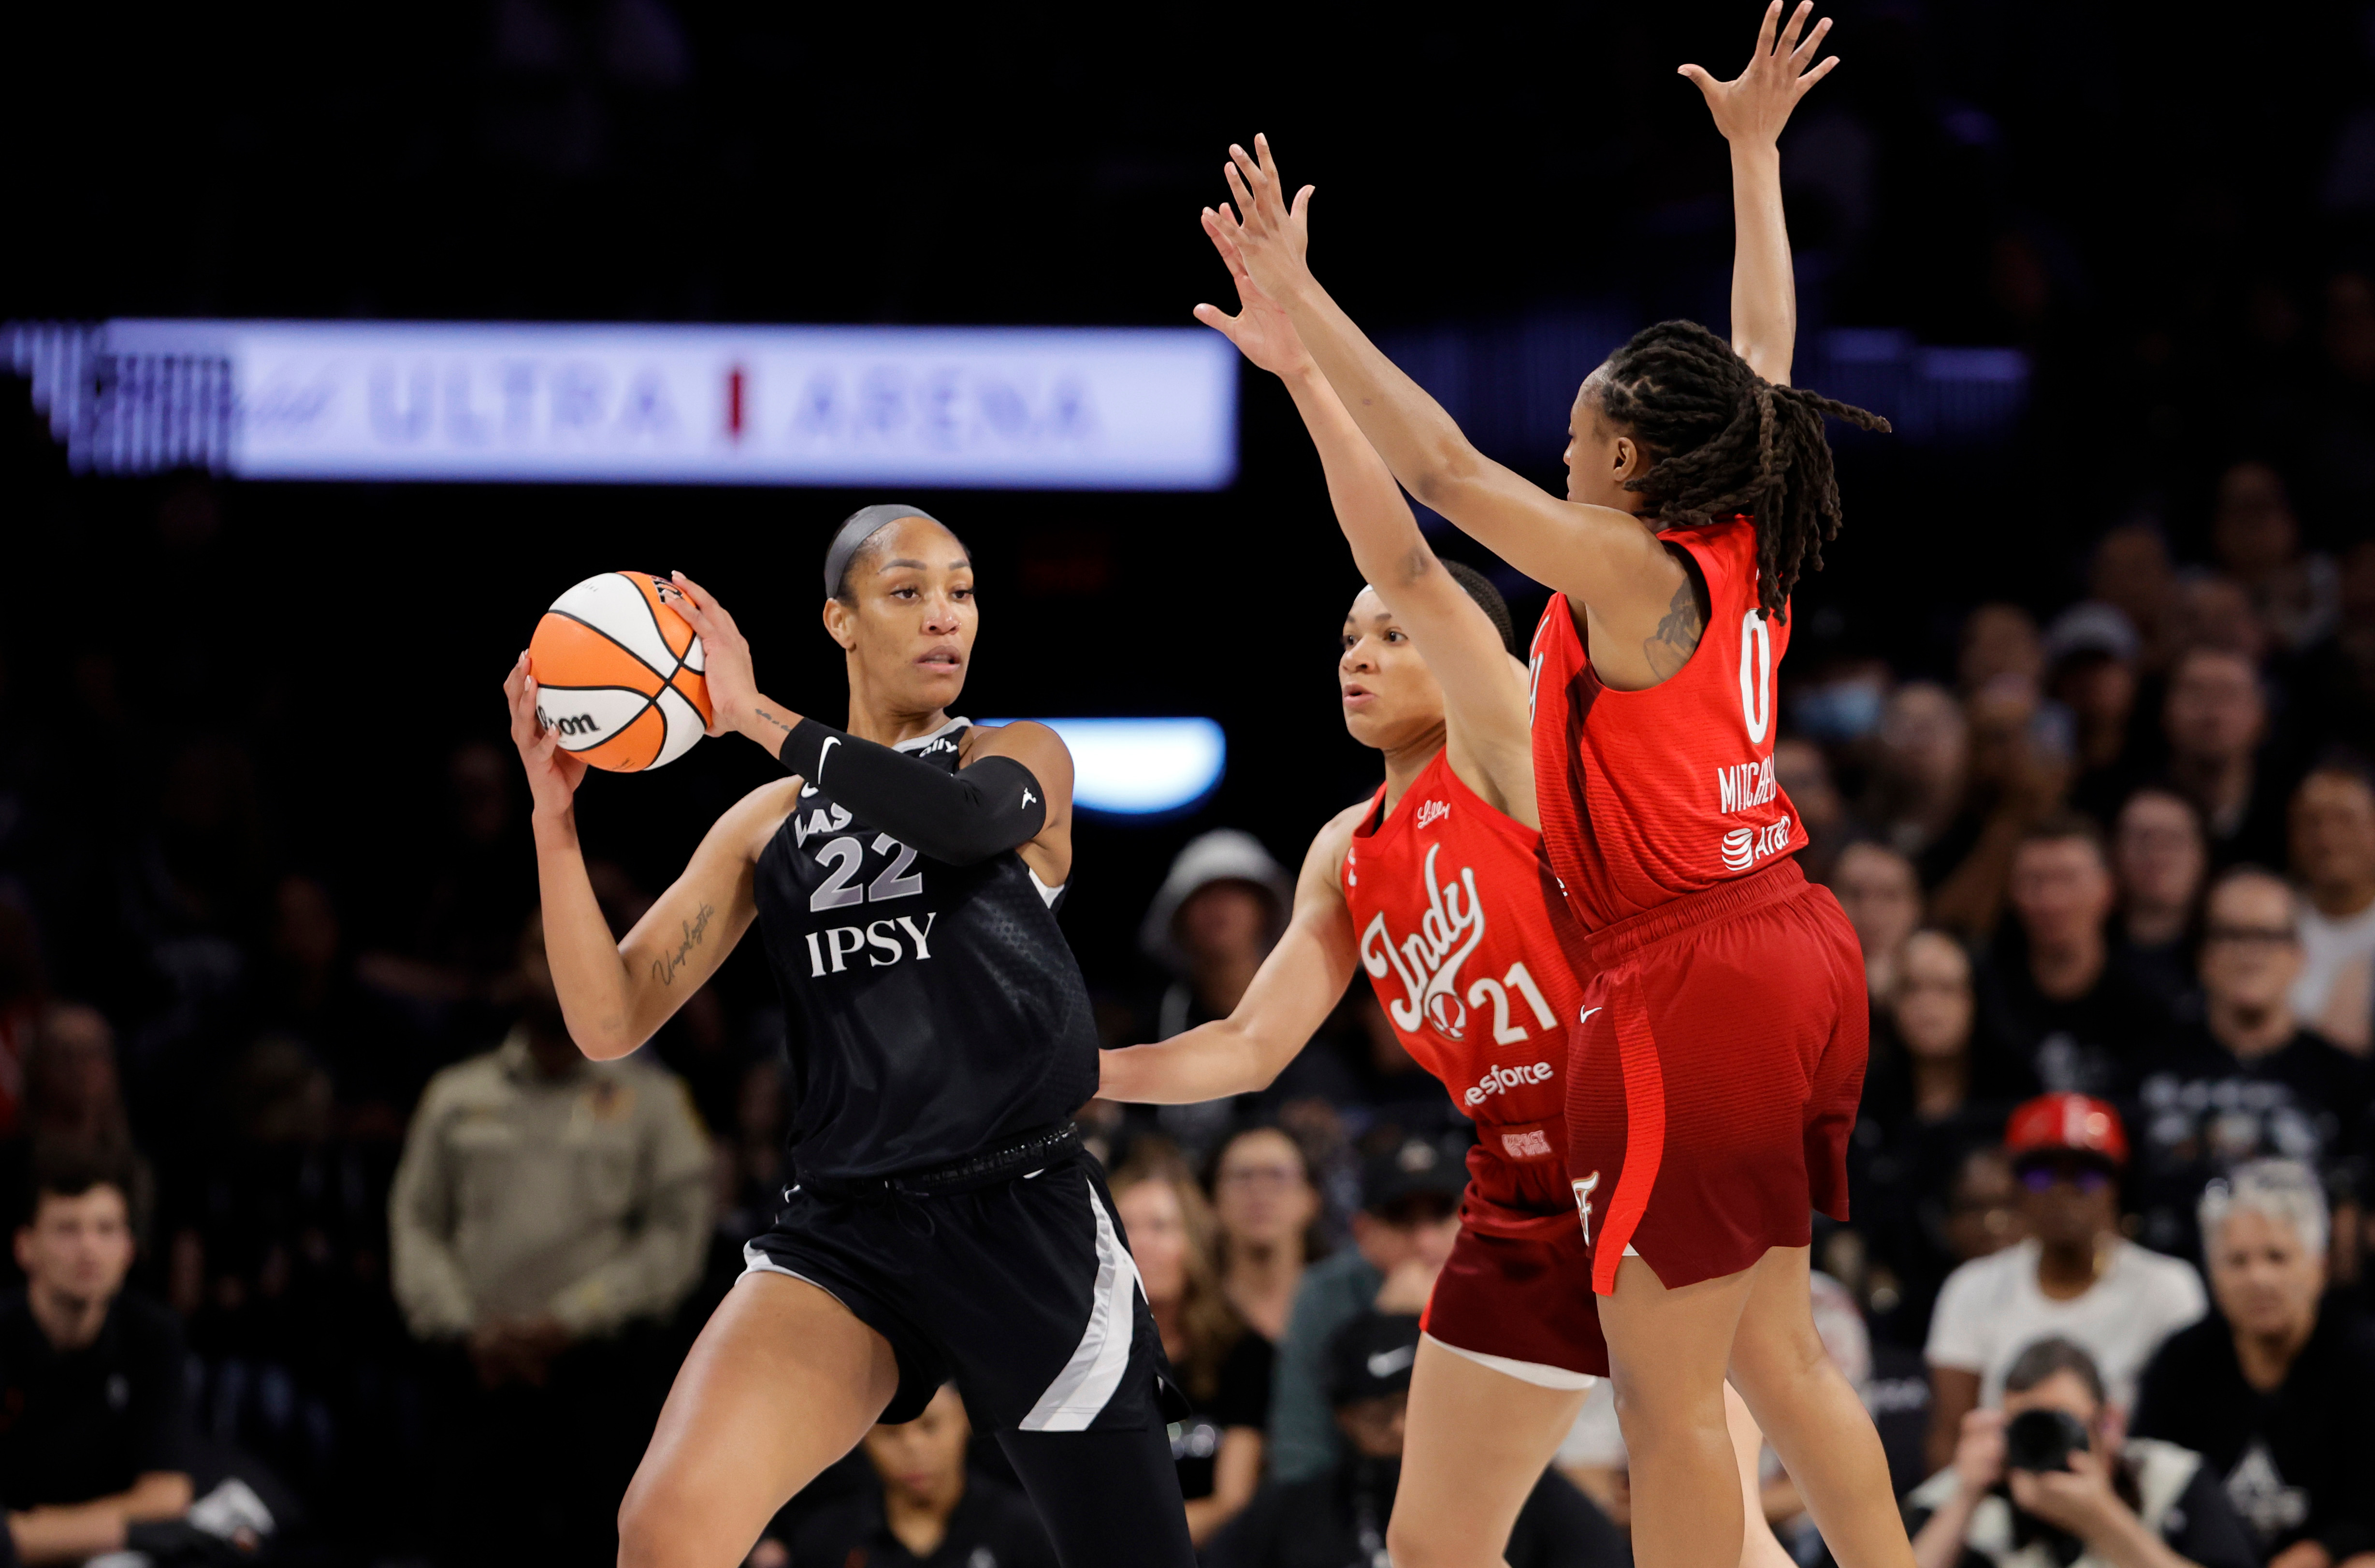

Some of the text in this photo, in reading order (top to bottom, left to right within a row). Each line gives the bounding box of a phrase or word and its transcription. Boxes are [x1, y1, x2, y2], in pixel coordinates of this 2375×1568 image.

[368, 357, 682, 448] ULTRA
[1739, 608, 1771, 745] 0
[919, 738, 958, 758] ally
[1417, 799, 1451, 829] Lilly
[810, 832, 923, 912] 22
[805, 912, 937, 978] IPSY
[1361, 842, 1485, 1033] Indy
[1467, 961, 1558, 1045] 21
